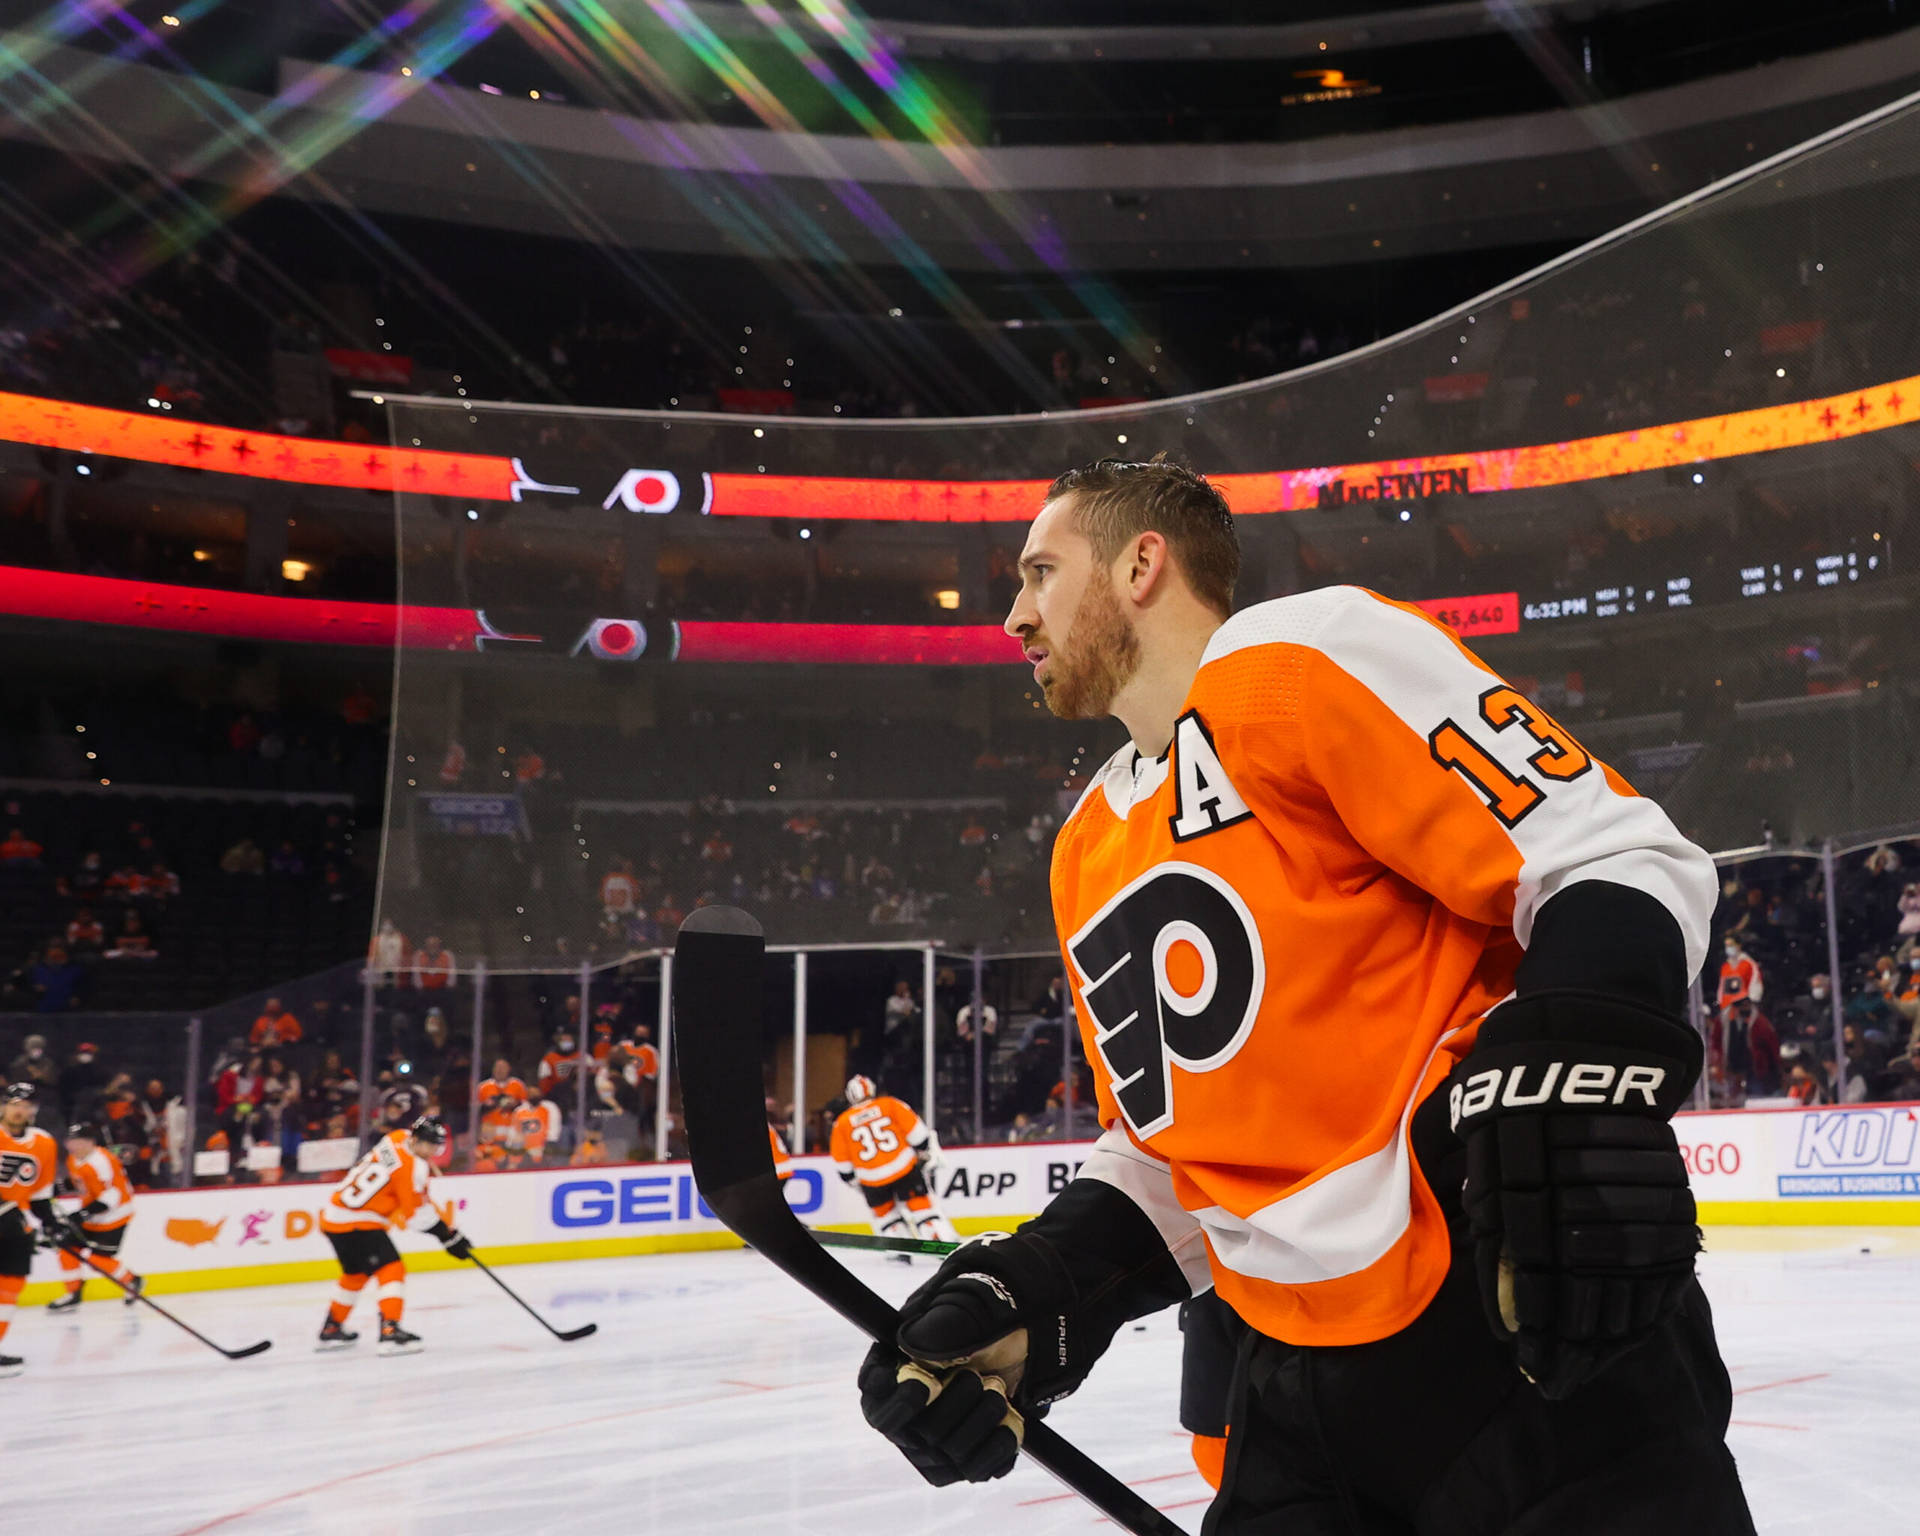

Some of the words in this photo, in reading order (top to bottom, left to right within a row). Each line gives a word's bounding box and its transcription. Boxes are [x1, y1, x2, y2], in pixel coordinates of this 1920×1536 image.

[1524, 601, 1560, 620] 6:32
[1561, 597, 1588, 615] PM
[1169, 707, 1254, 843] A
[1428, 684, 1593, 831] 13
[1450, 1062, 1665, 1134] BAUER
[851, 1116, 899, 1162] 35
[551, 1168, 823, 1228] GEIO
